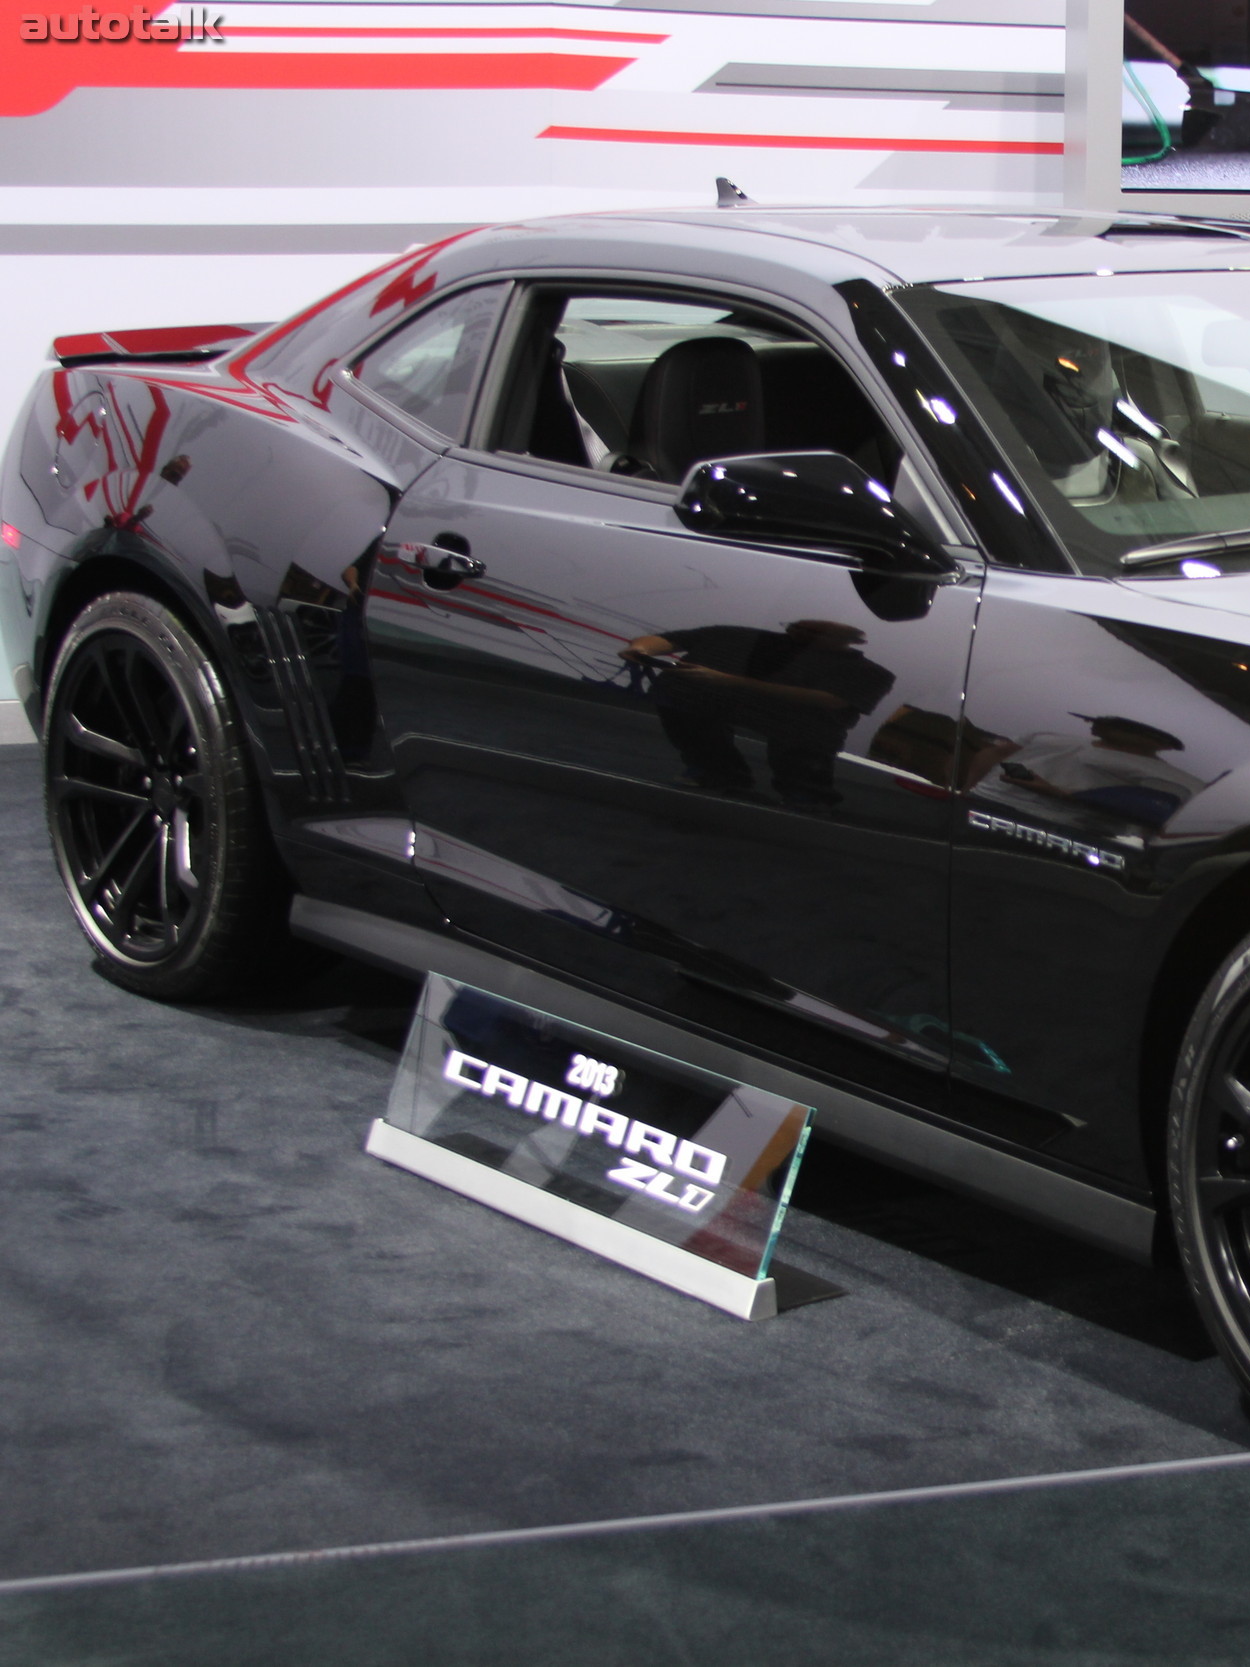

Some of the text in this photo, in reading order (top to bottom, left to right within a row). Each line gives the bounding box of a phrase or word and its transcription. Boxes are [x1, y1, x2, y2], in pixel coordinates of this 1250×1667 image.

[968, 809, 1126, 870] CAMARO
[567, 1053, 619, 1096] 2013
[444, 1049, 727, 1185] CAMARO
